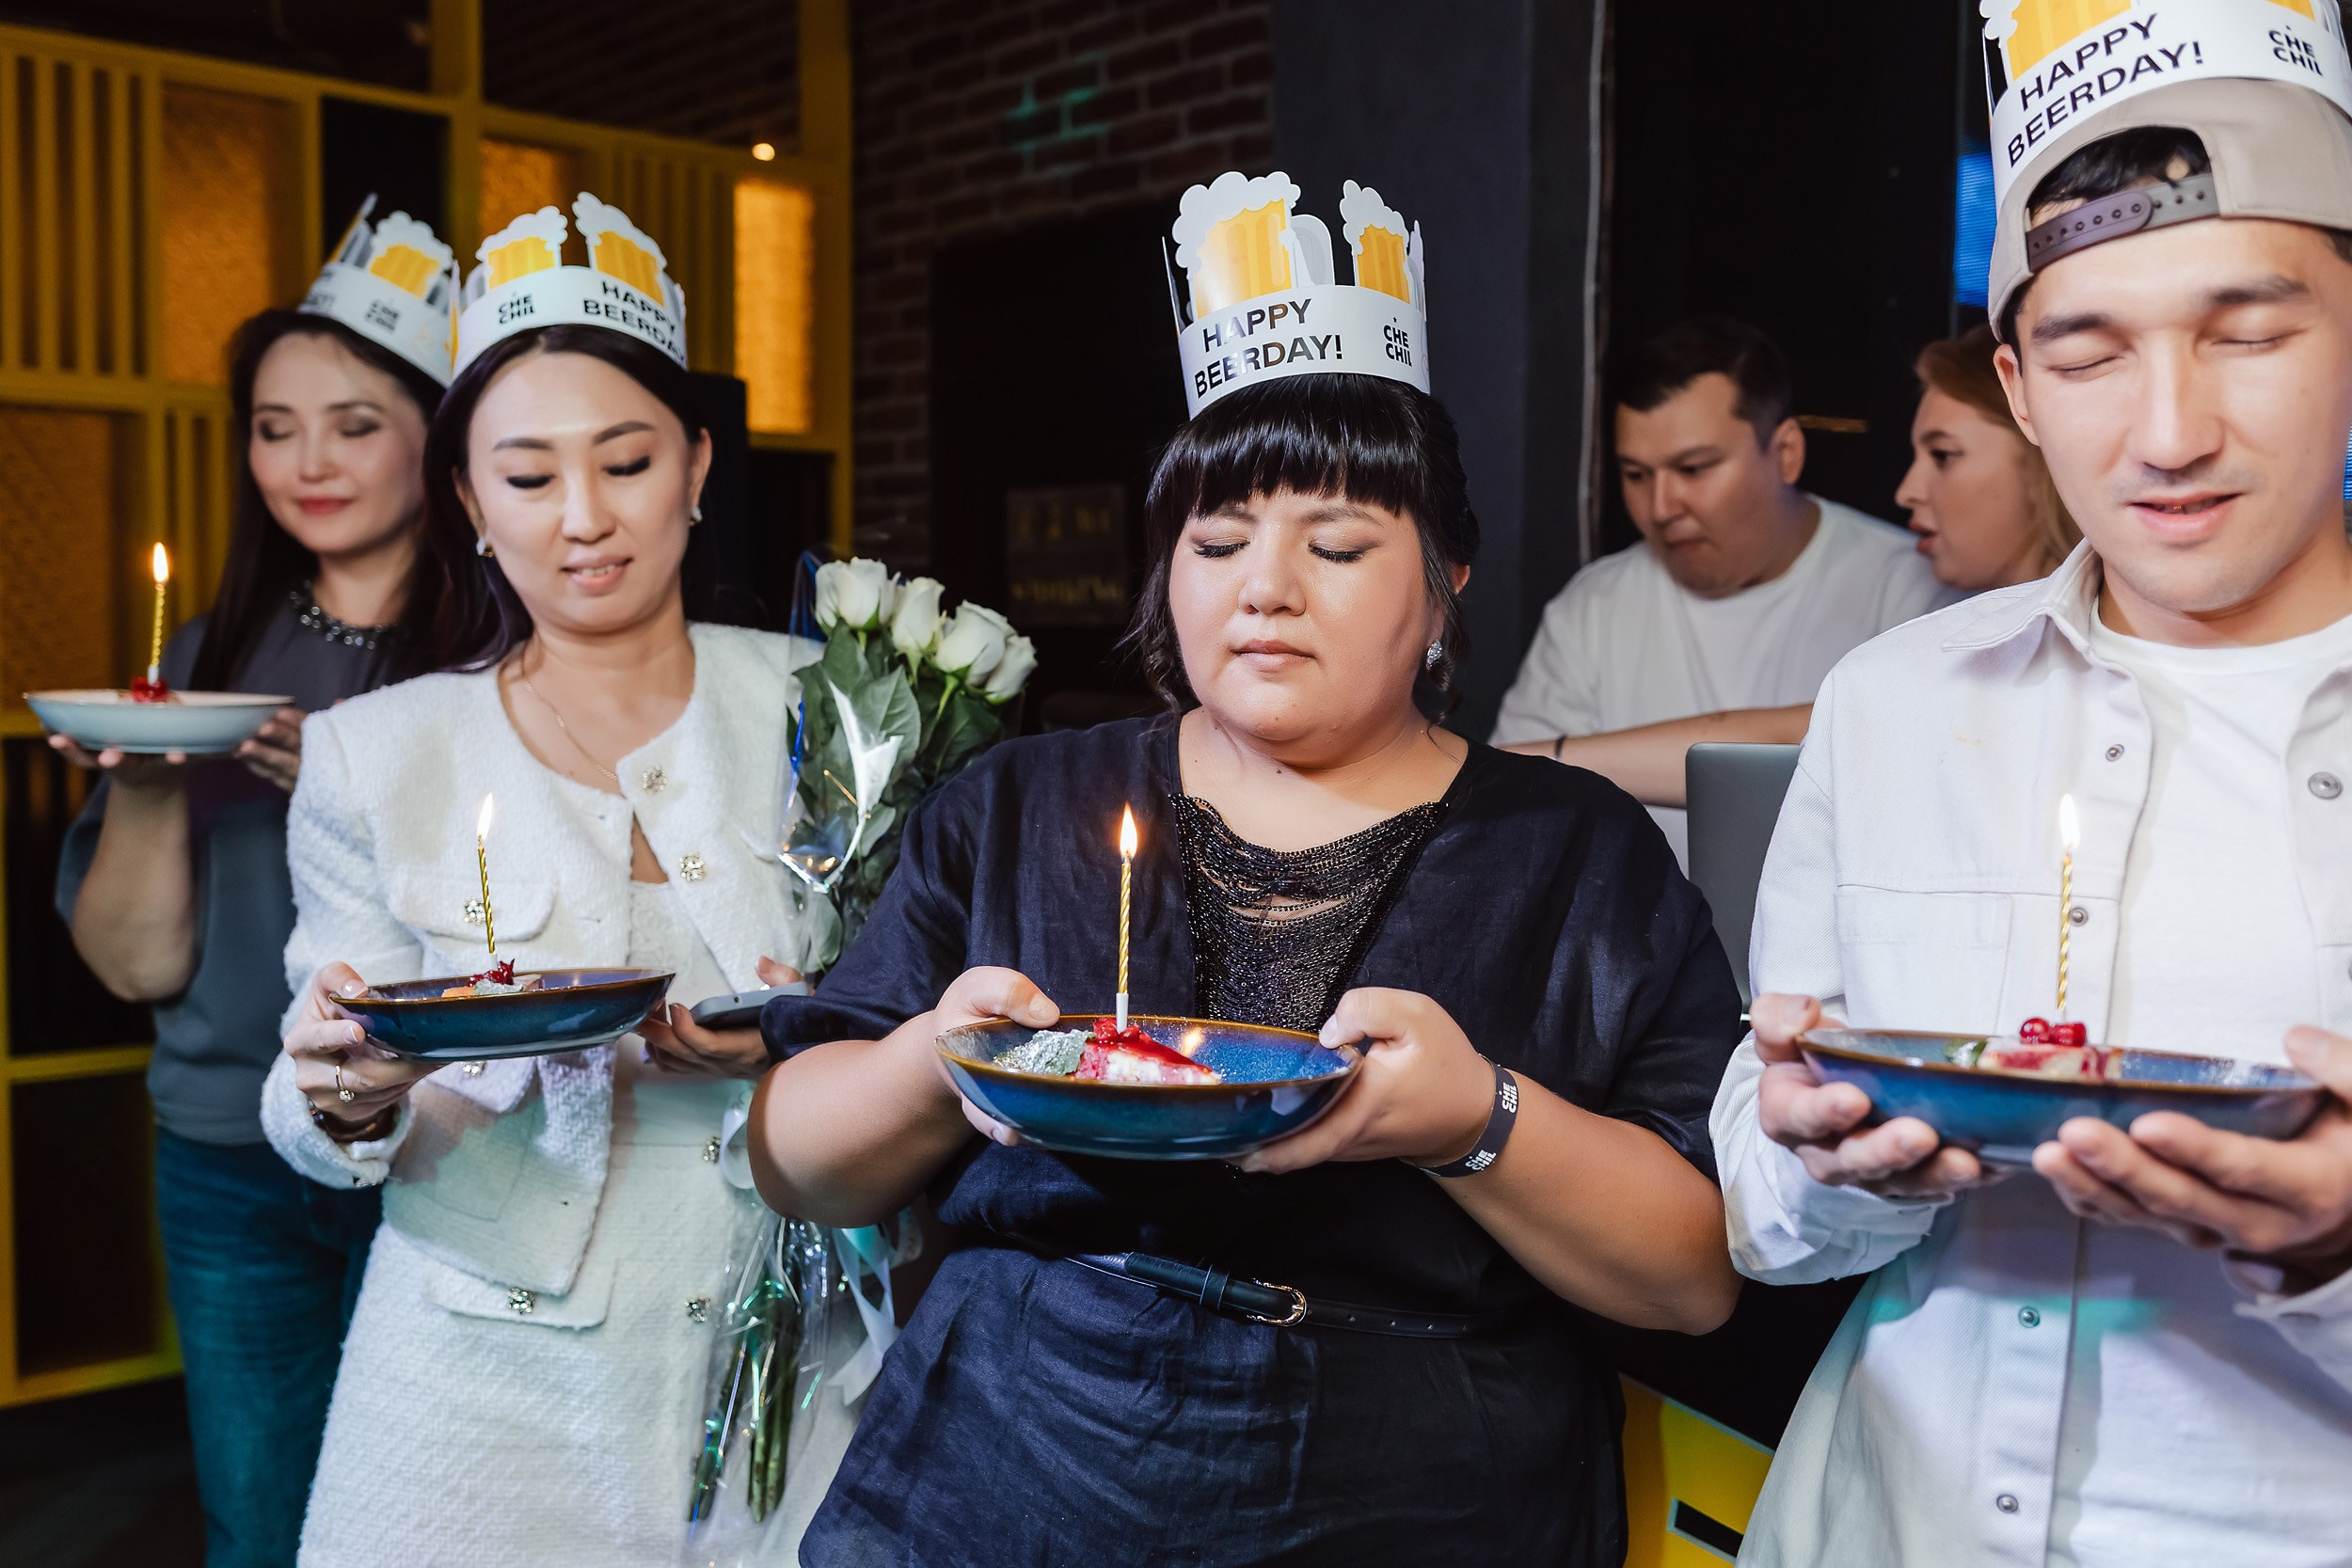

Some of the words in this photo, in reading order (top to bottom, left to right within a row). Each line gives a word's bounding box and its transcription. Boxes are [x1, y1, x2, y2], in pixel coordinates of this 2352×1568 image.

[2268, 29, 2316, 58] CHE
[2020, 12, 2158, 112] HAPPY
[2273, 46, 2325, 77] CHIL
[2007, 40, 2204, 168] BEERDAY!
[499, 294, 532, 313] CHE
[499, 306, 534, 325] CHIL
[602, 280, 675, 335] HAPPY
[1202, 298, 1312, 354] HAPPY
[1383, 325, 1410, 349] CHE
[1194, 334, 1343, 399] BEERDAY!
[1385, 342, 1413, 367] CHIL
[1502, 1082, 1512, 1110] CHE
[1508, 1085, 1518, 1114] CHIL
[1465, 1149, 1488, 1167] CHE
